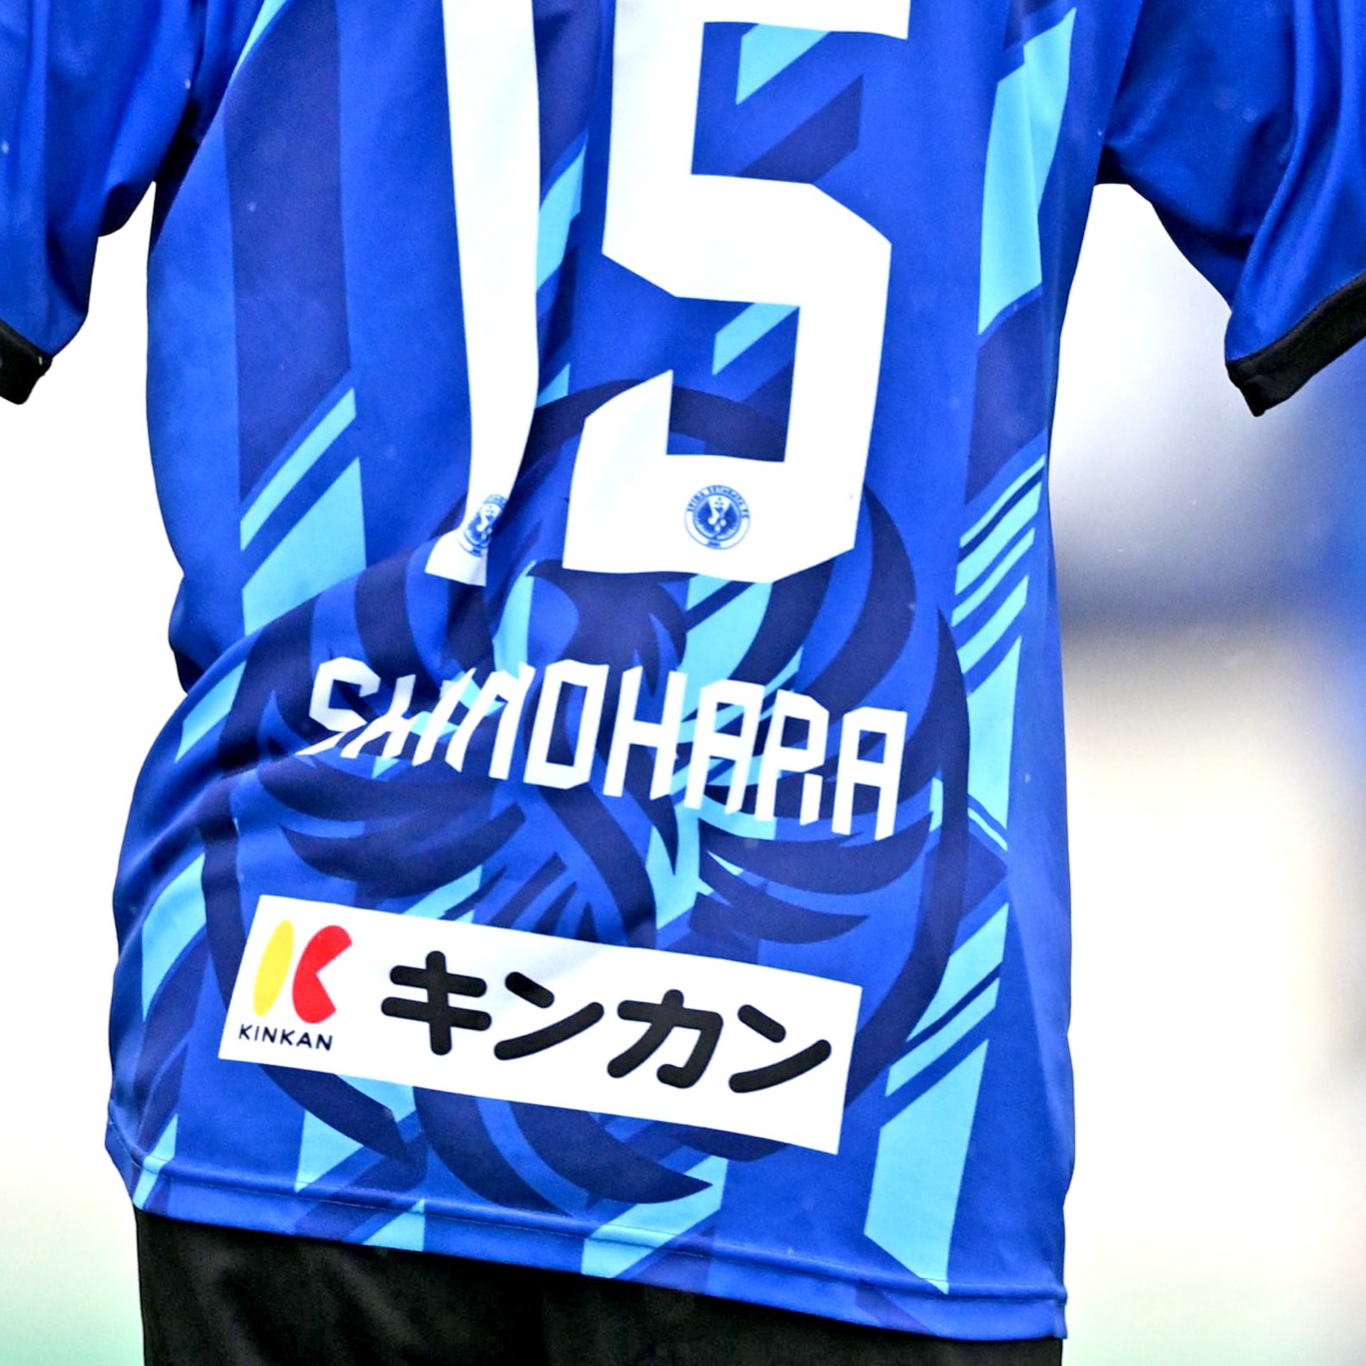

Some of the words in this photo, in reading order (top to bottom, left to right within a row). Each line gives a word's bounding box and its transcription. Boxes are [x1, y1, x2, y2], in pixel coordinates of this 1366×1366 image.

[295, 656, 907, 841] SHINOHARA
[238, 1023, 333, 1051] KINKAN
[380, 950, 832, 1094] キンカン
